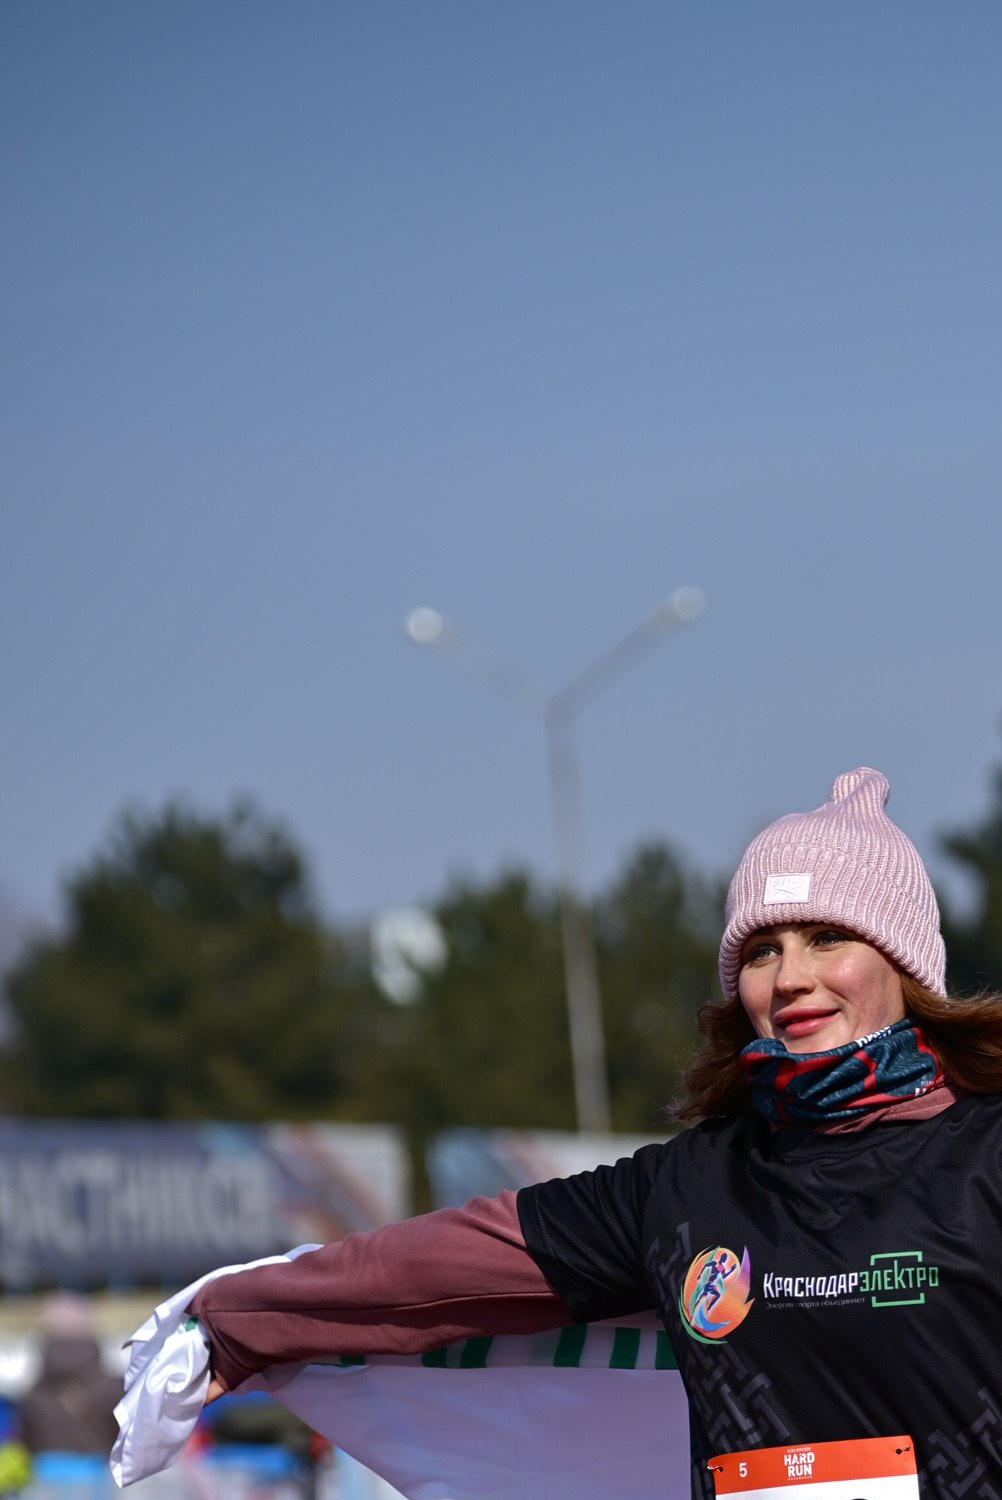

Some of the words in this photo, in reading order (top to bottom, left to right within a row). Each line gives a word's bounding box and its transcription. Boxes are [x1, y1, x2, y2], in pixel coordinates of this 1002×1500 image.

[784, 1452, 815, 1466] HARD
[739, 1463, 748, 1478] 5
[788, 1464, 813, 1478] RUN
